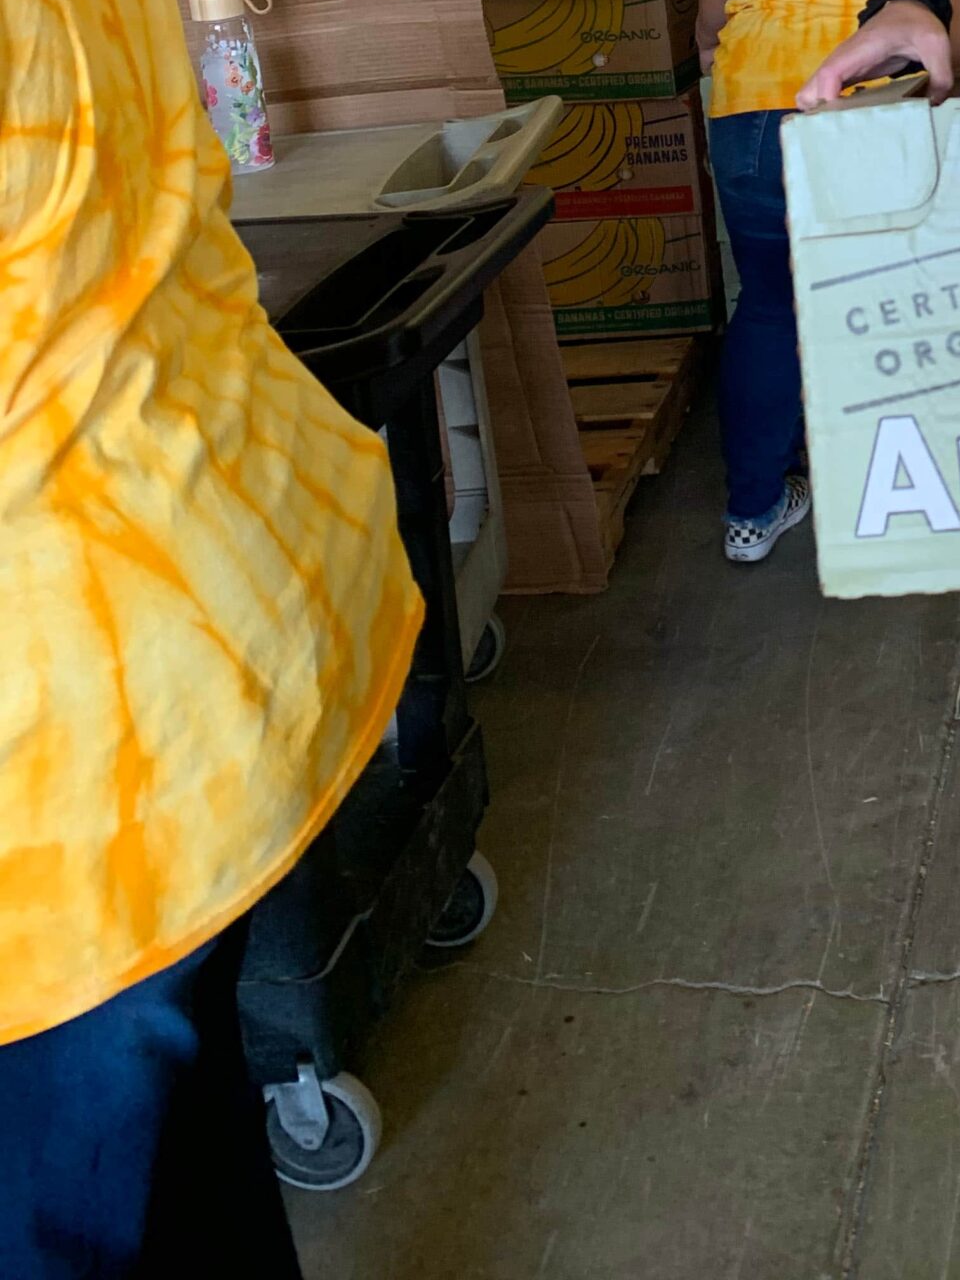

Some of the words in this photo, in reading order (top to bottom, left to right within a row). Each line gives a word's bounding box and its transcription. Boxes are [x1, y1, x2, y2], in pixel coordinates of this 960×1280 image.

[580, 27, 661, 44] ORGANIC
[625, 133, 686, 148] PREMIUM
[627, 149, 688, 166] BANANAS
[620, 260, 701, 277] ORGANIC
